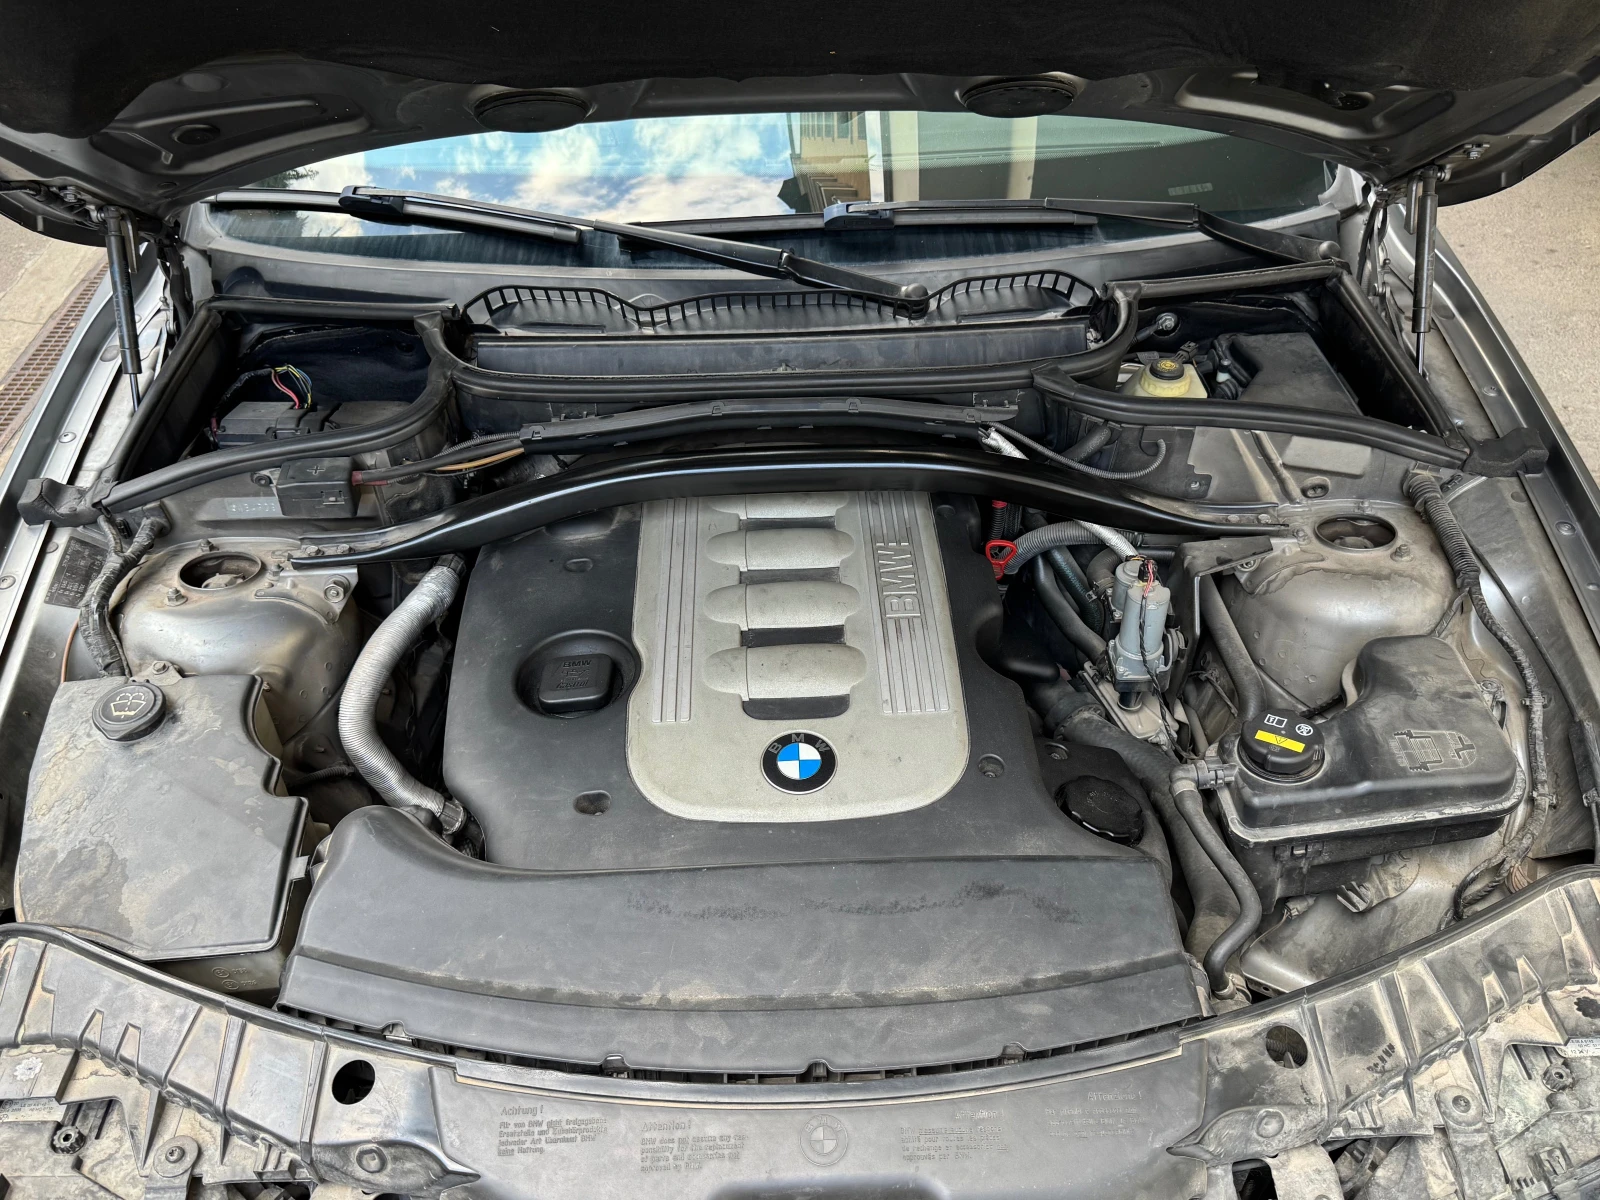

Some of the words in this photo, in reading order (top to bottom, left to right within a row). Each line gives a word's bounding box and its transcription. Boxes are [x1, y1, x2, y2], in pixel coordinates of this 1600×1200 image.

[876, 542, 921, 619] BMW
[563, 660, 592, 668] BMW
[500, 1105, 538, 1117] Achtung
[514, 1121, 526, 1129] von
[528, 1120, 544, 1128] BMW
[641, 1120, 686, 1132] Attention
[537, 1128, 550, 1136] und
[581, 1134, 597, 1143] BMW
[641, 1137, 657, 1146] BMW
